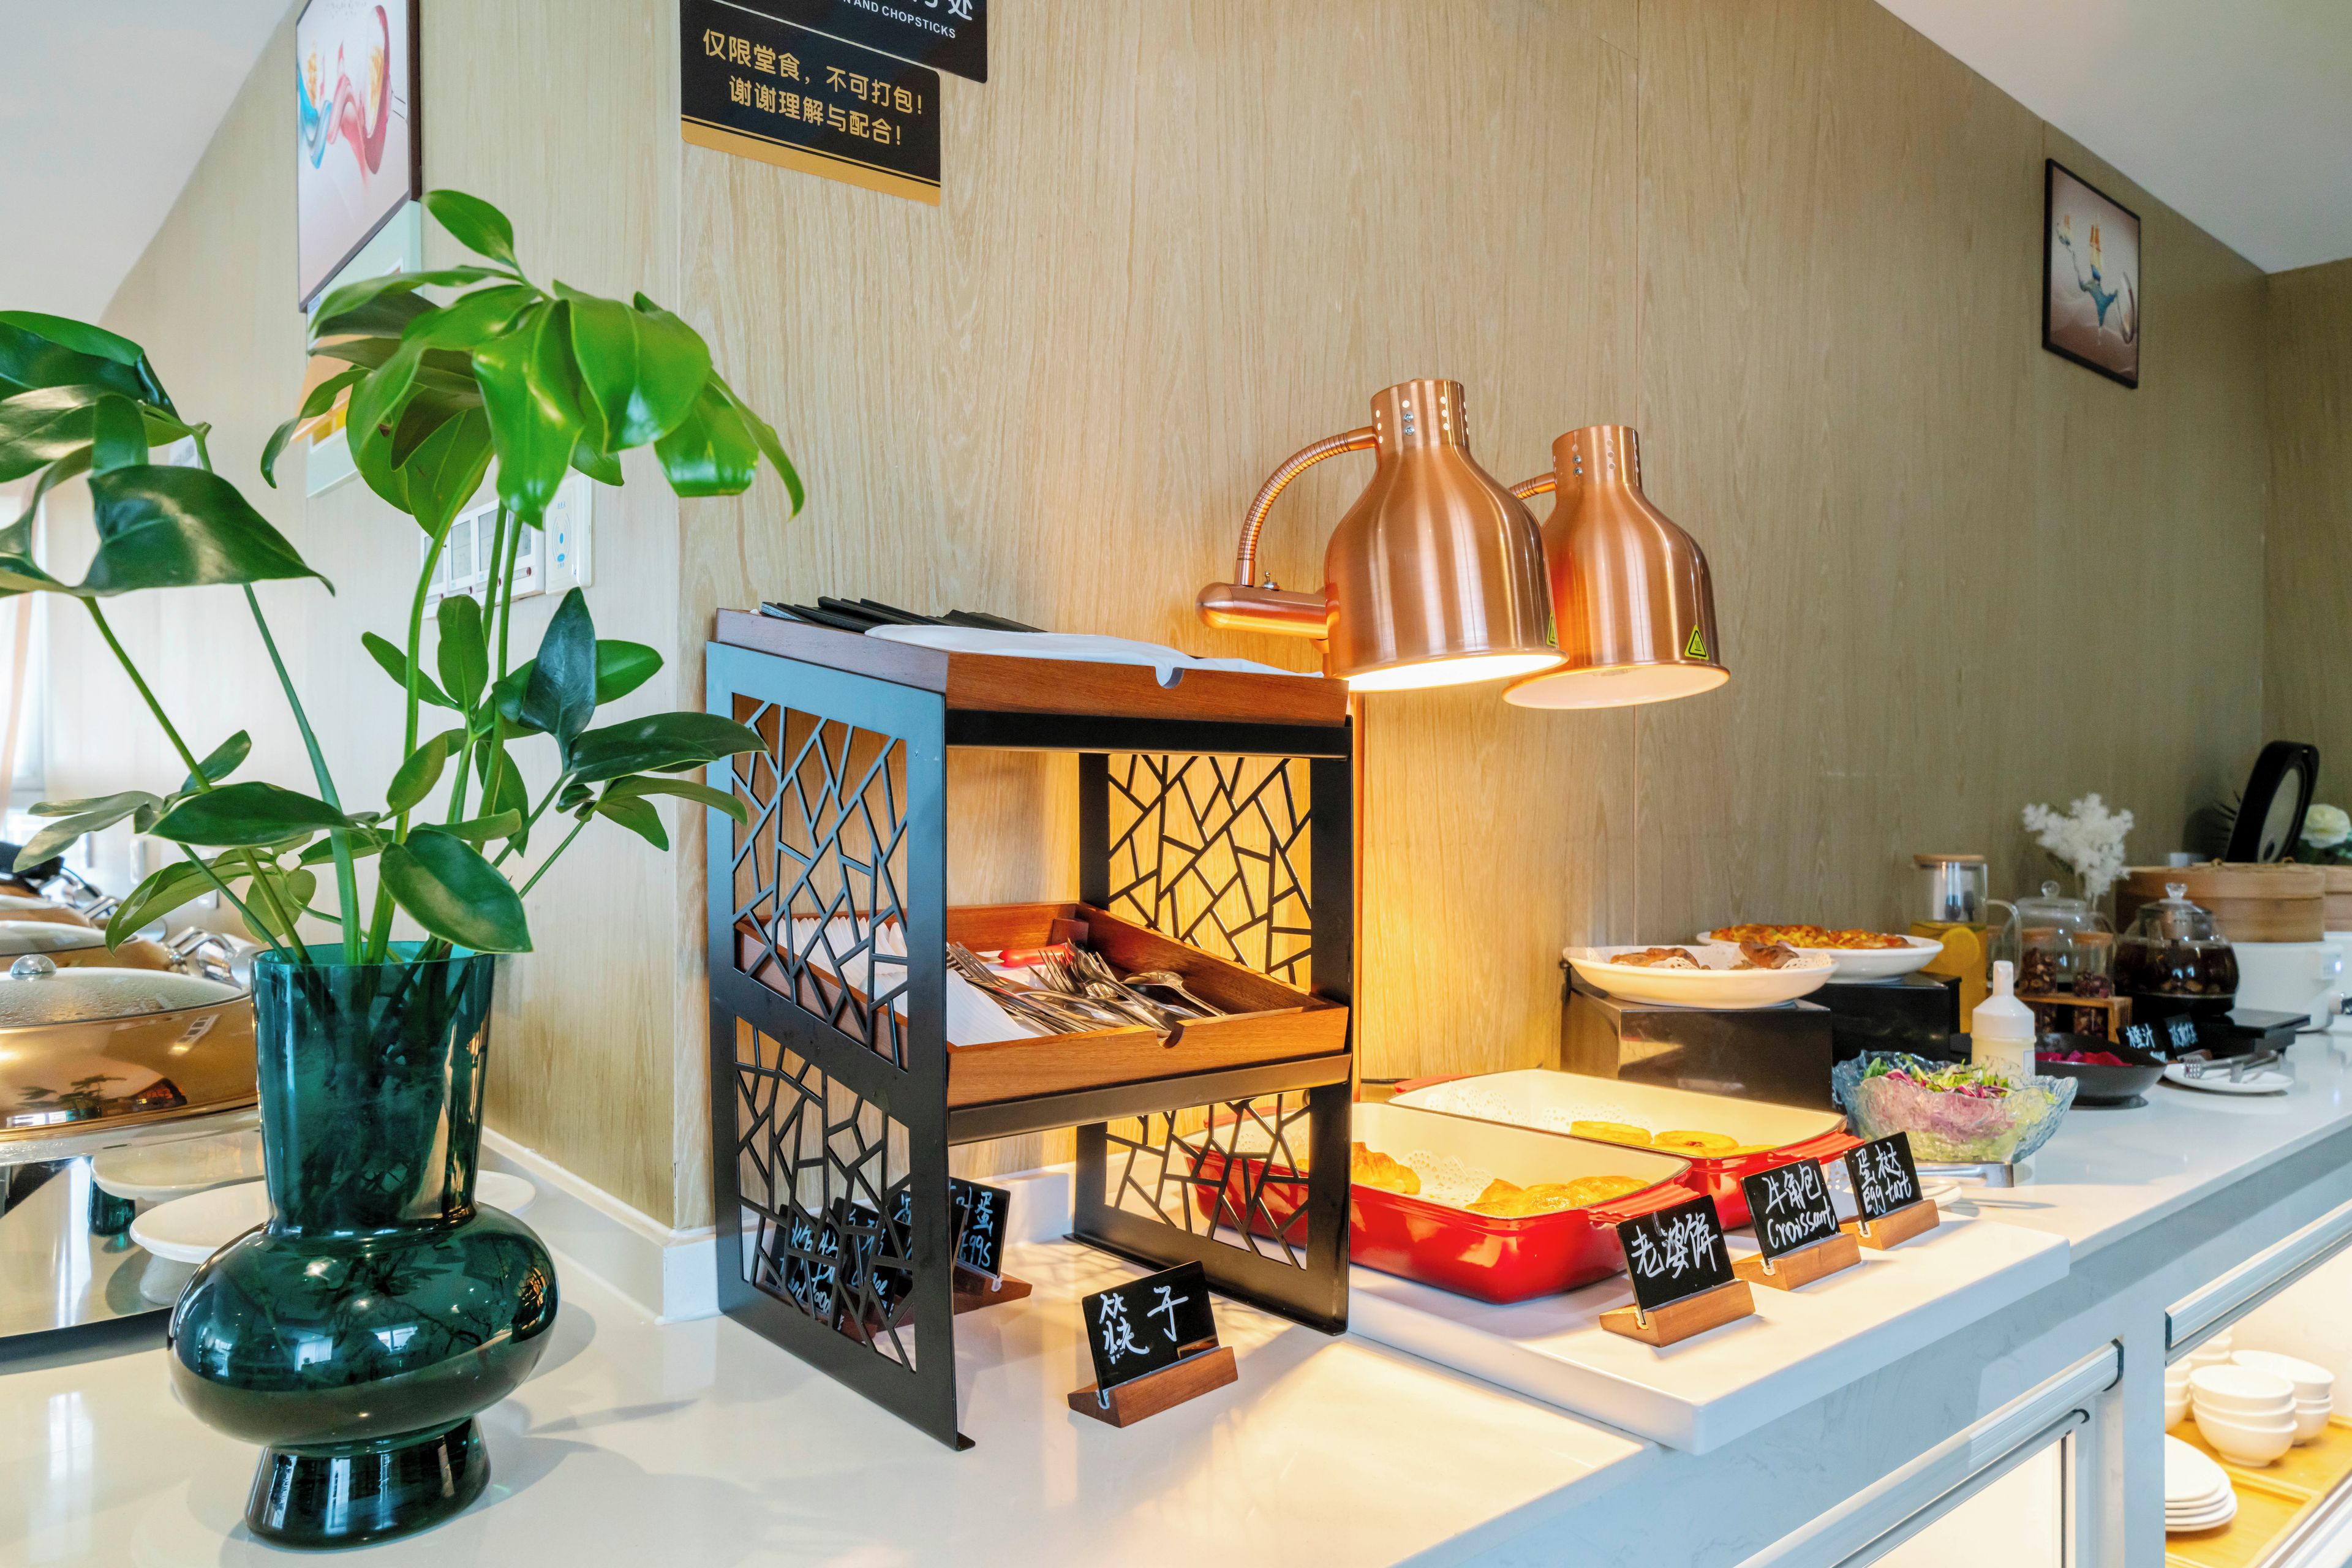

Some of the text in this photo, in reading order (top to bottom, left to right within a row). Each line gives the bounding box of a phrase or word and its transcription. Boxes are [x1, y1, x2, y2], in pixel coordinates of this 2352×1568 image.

[854, 0, 956, 39] AND CHOPSTICKS
[703, 29, 922, 115] 仅限堂食，不可打包！
[729, 75, 901, 145] 谢谢理解与配合！
[1762, 1164, 1822, 1214] 牛角包
[1863, 1170, 1912, 1215] Egg tart
[1631, 1213, 1718, 1279] 老婆饼
[1767, 1196, 1836, 1249] Croissant
[1099, 1286, 1189, 1365] 筷子
